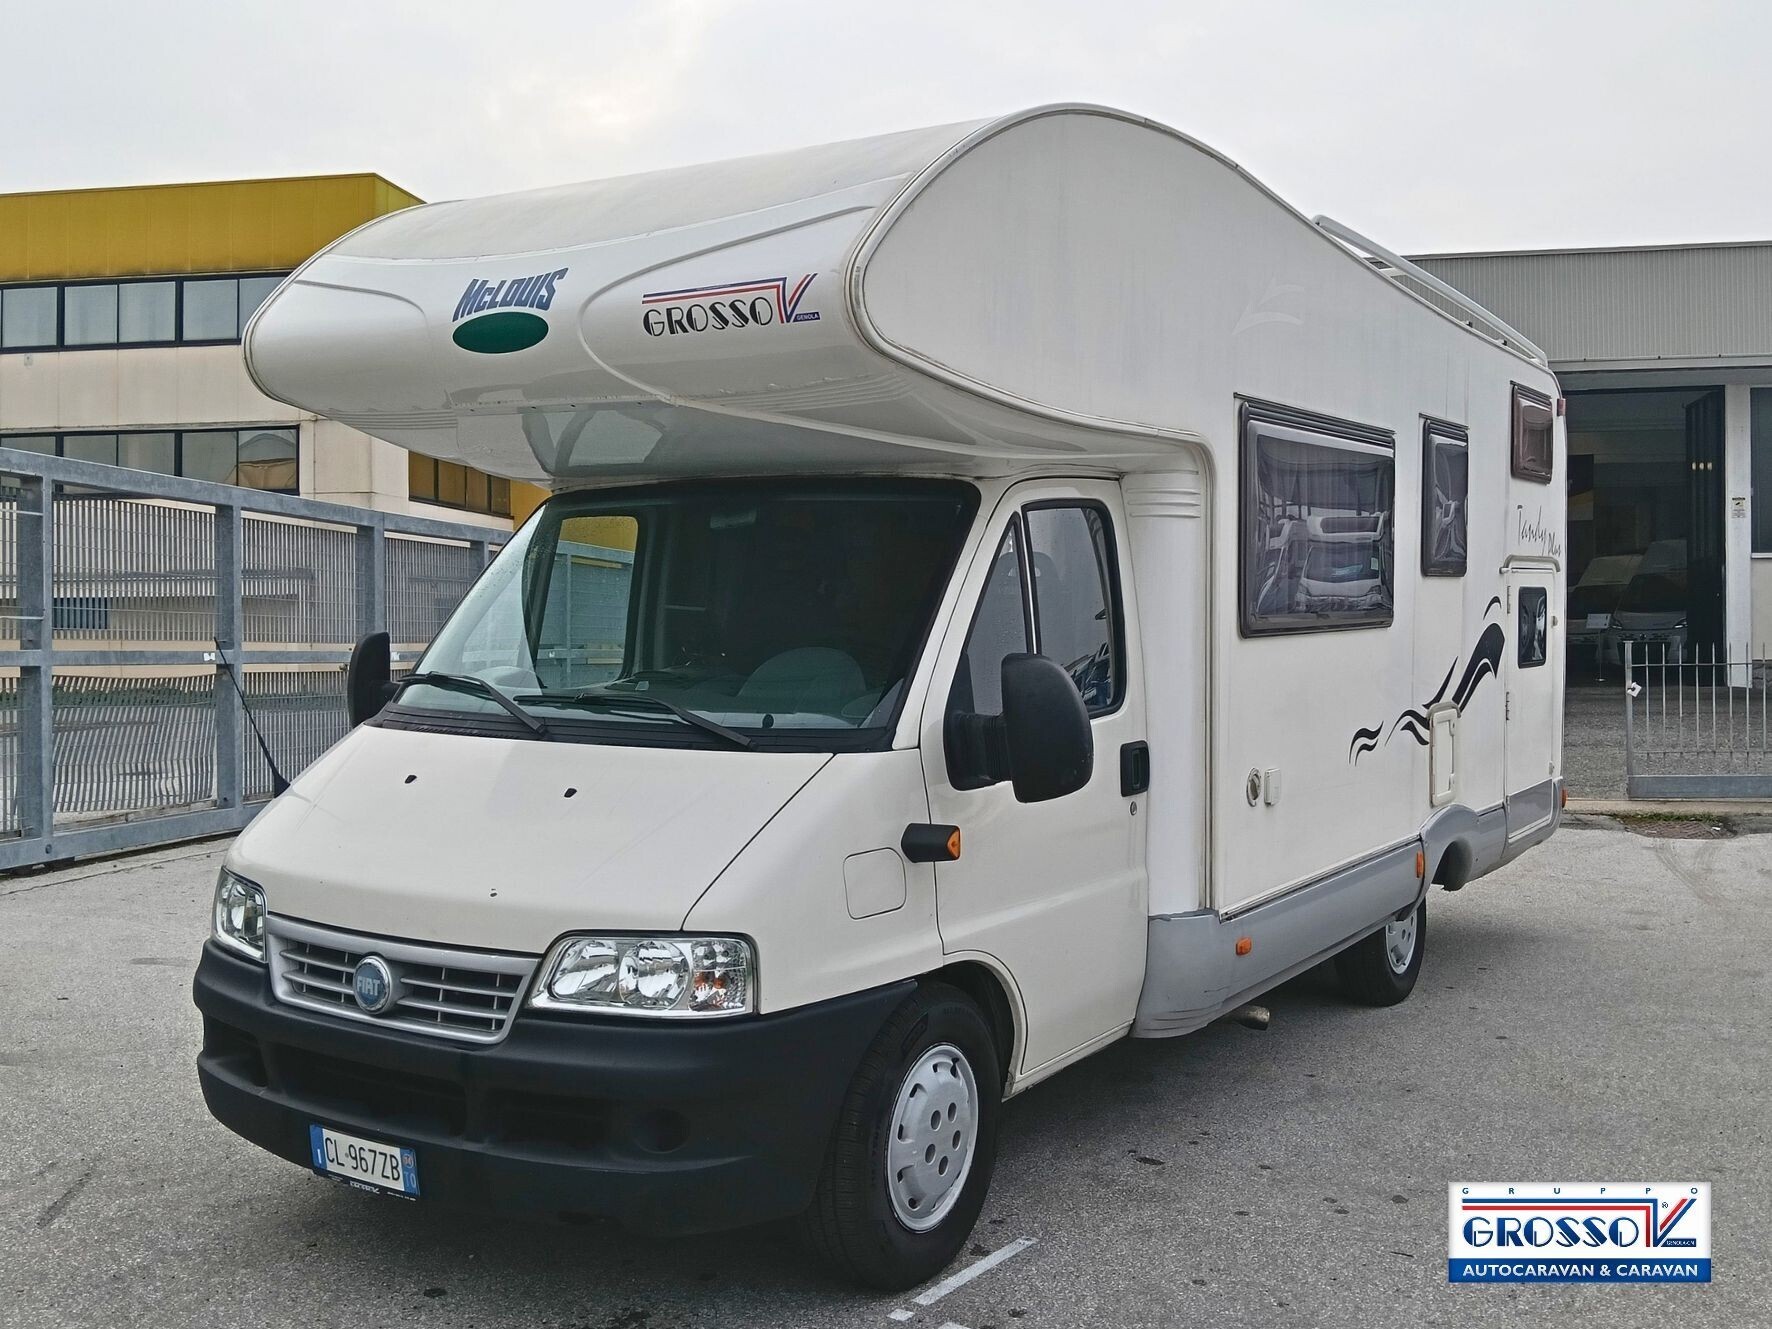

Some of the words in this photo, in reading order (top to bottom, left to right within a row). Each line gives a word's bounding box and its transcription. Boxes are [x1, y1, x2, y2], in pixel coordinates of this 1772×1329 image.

[643, 297, 773, 336] GROSSO
[357, 976, 380, 996] FIAT
[325, 1137, 345, 1166] CL
[348, 1144, 400, 1180] 967ZB
